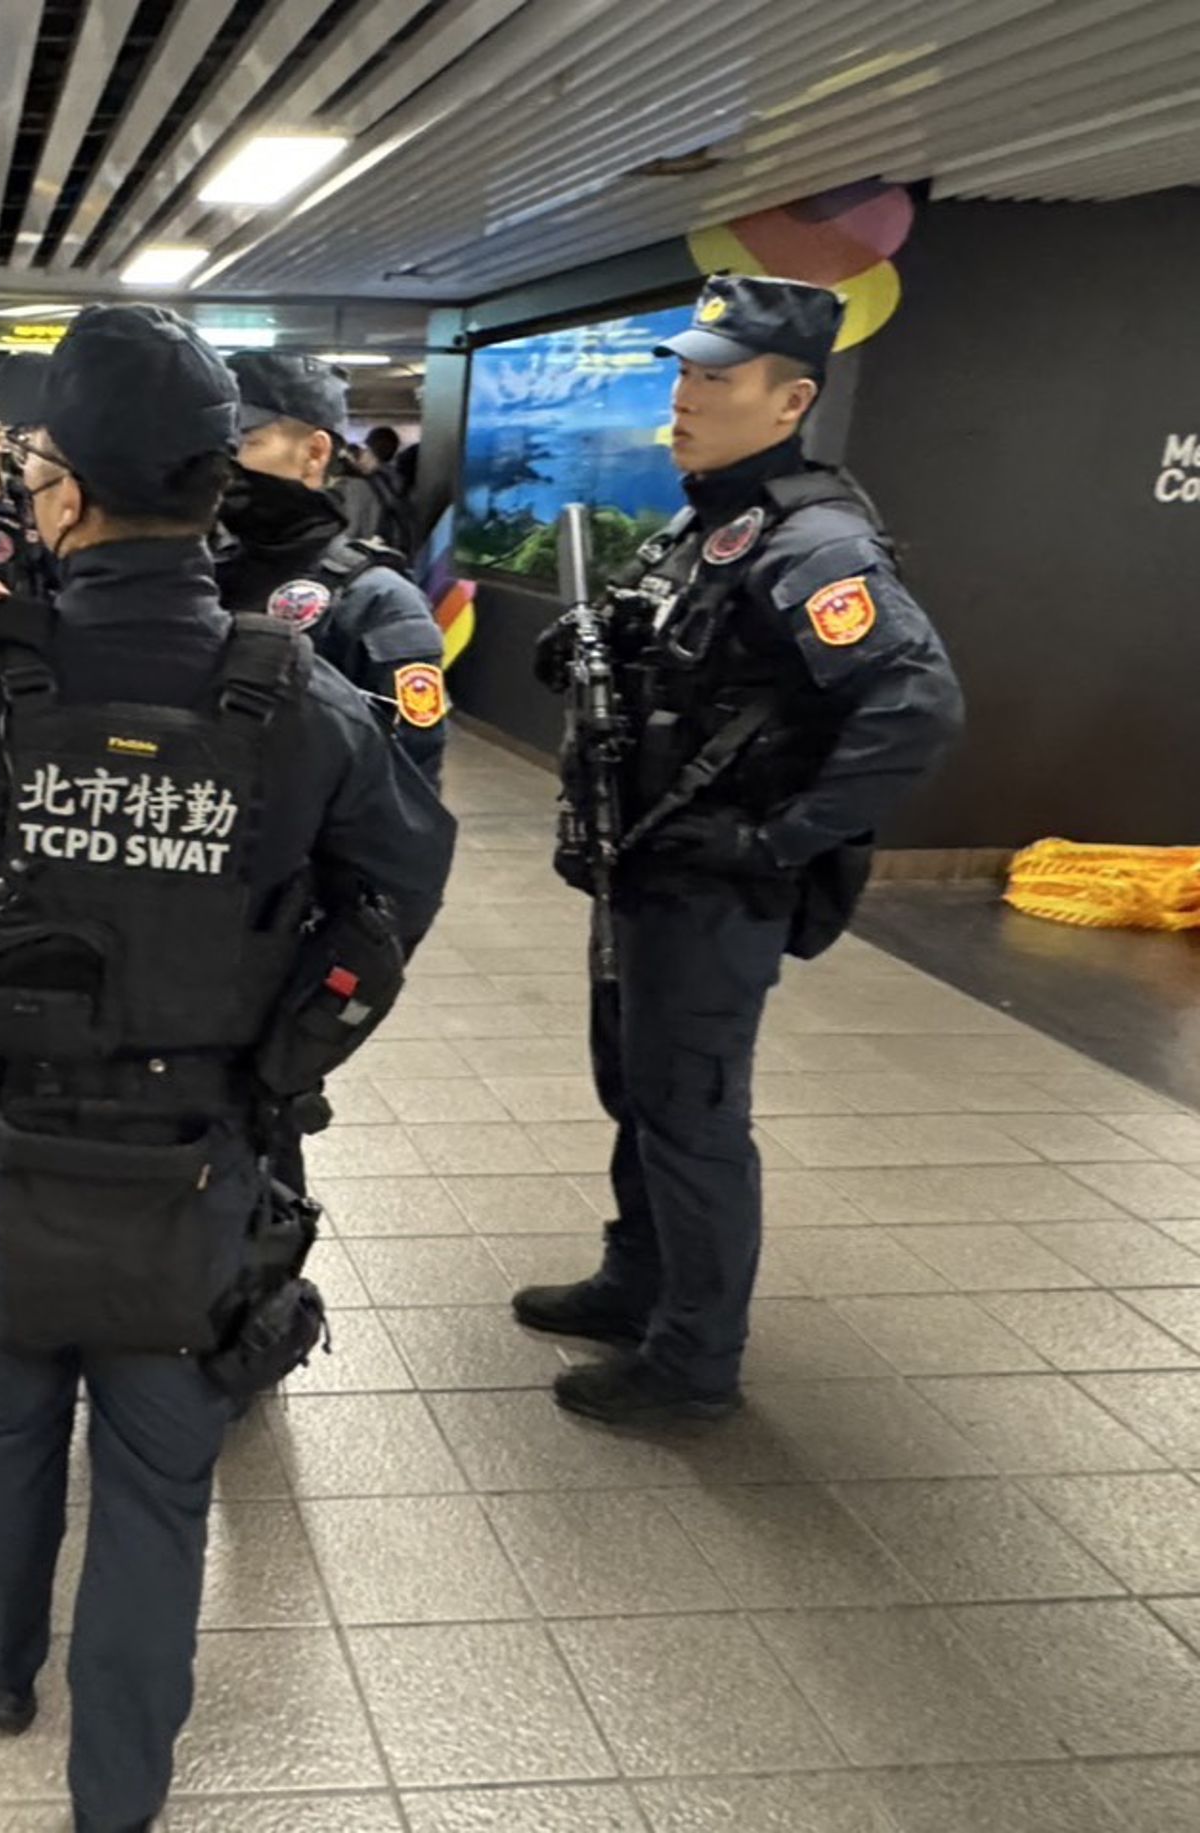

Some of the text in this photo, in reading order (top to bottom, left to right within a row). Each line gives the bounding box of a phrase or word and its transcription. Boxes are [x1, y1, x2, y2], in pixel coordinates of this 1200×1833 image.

[18, 764, 239, 838] 北市特勤
[18, 822, 231, 874] TCPD SWAT
